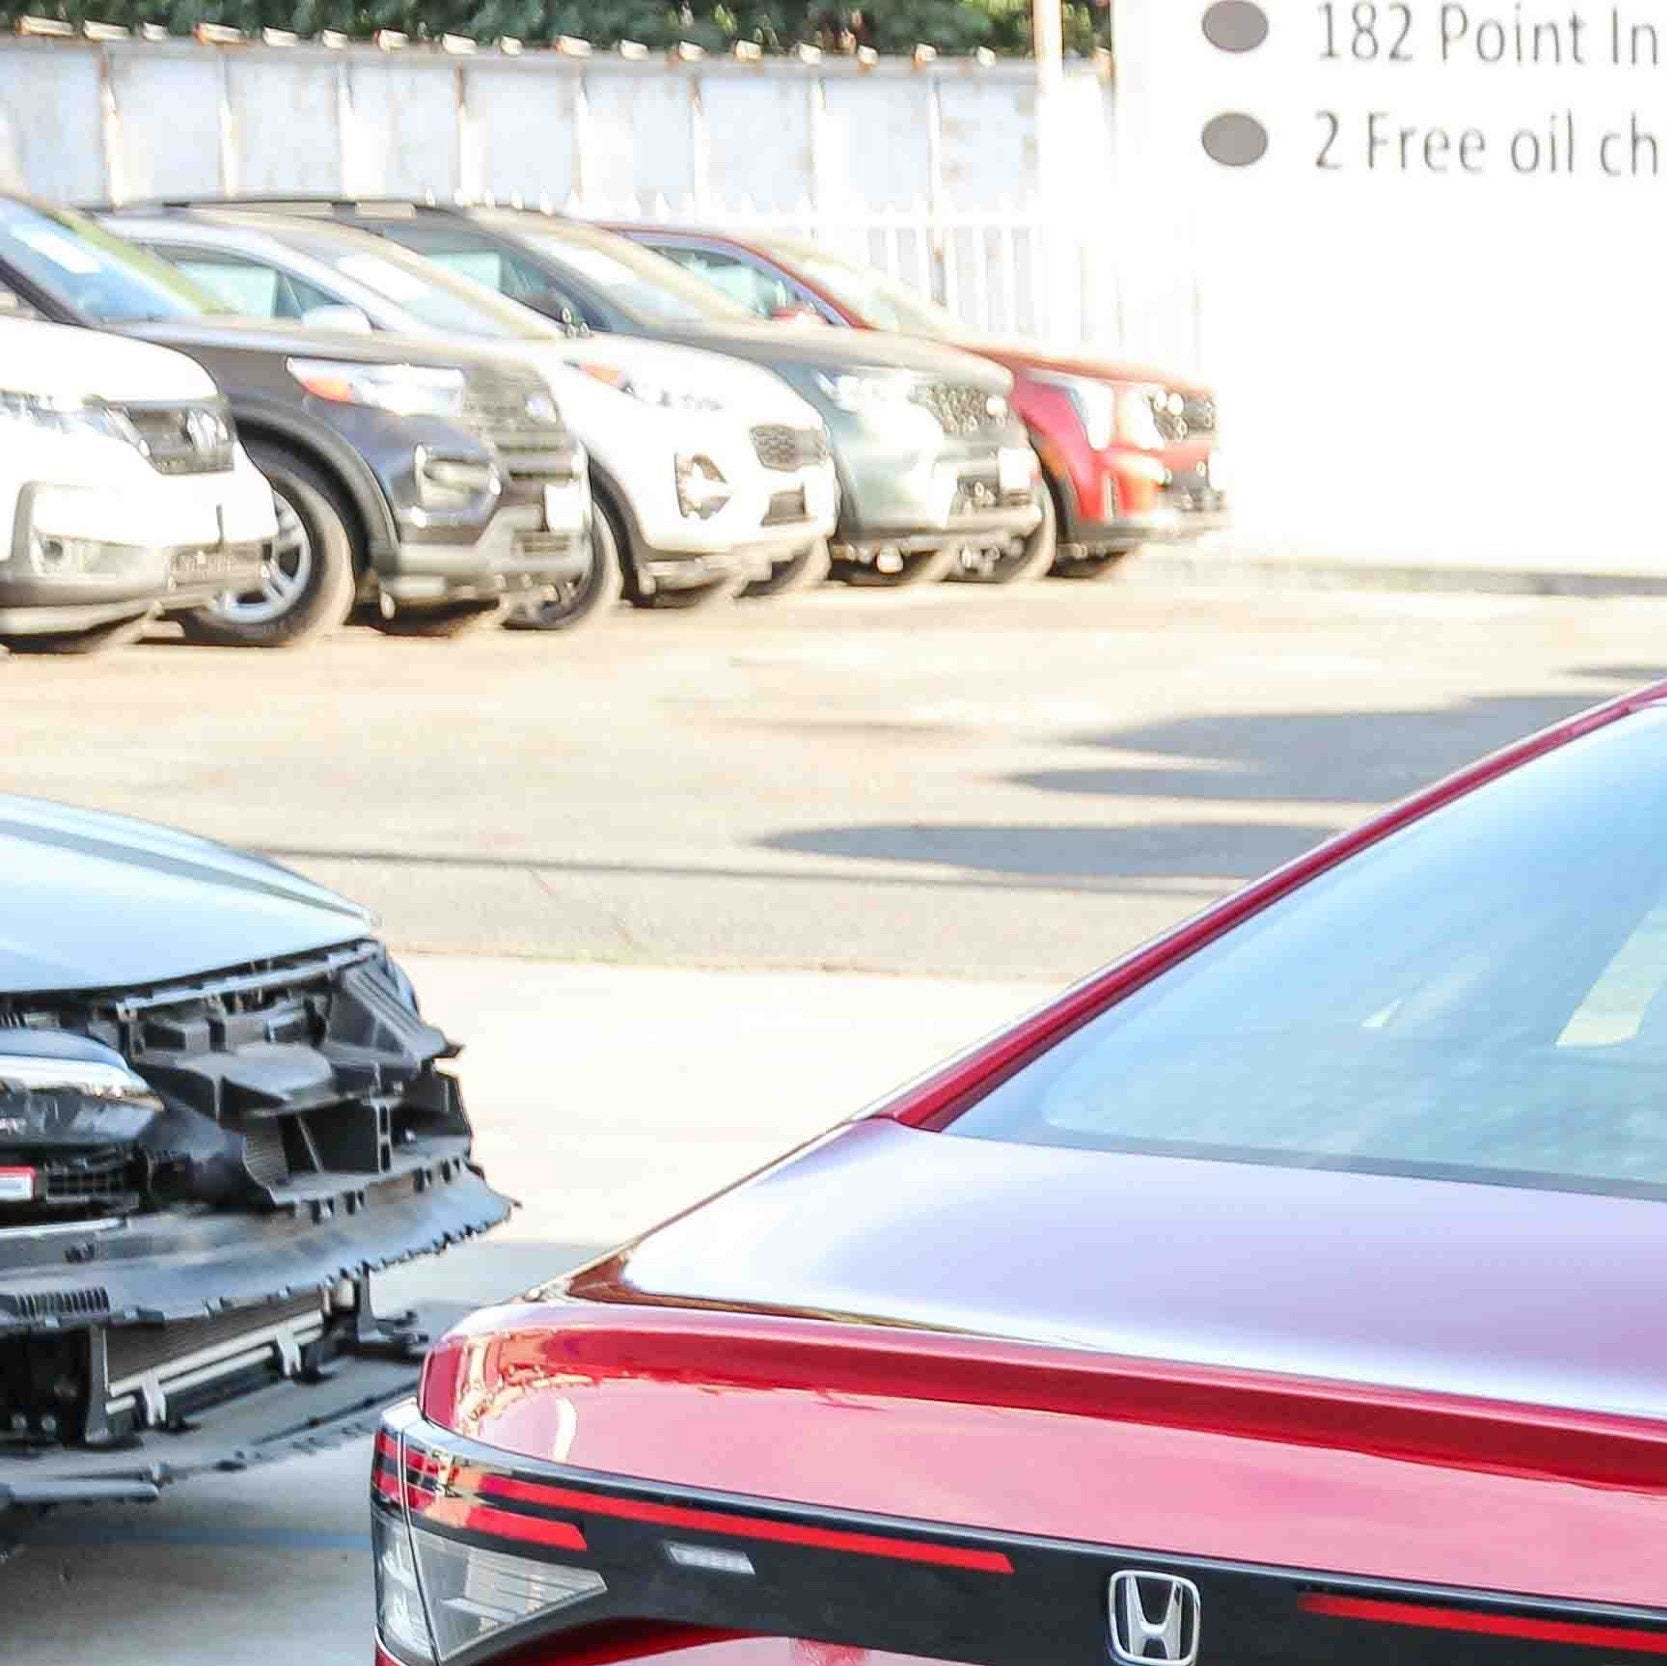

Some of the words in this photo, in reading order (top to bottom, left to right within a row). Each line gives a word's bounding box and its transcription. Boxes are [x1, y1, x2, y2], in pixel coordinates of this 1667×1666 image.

[1316, 1, 1413, 62] 182
[1440, 3, 1585, 65] Point
[1314, 110, 1342, 170] 2
[1367, 112, 1486, 172] Free
[1510, 109, 1575, 173] oil
